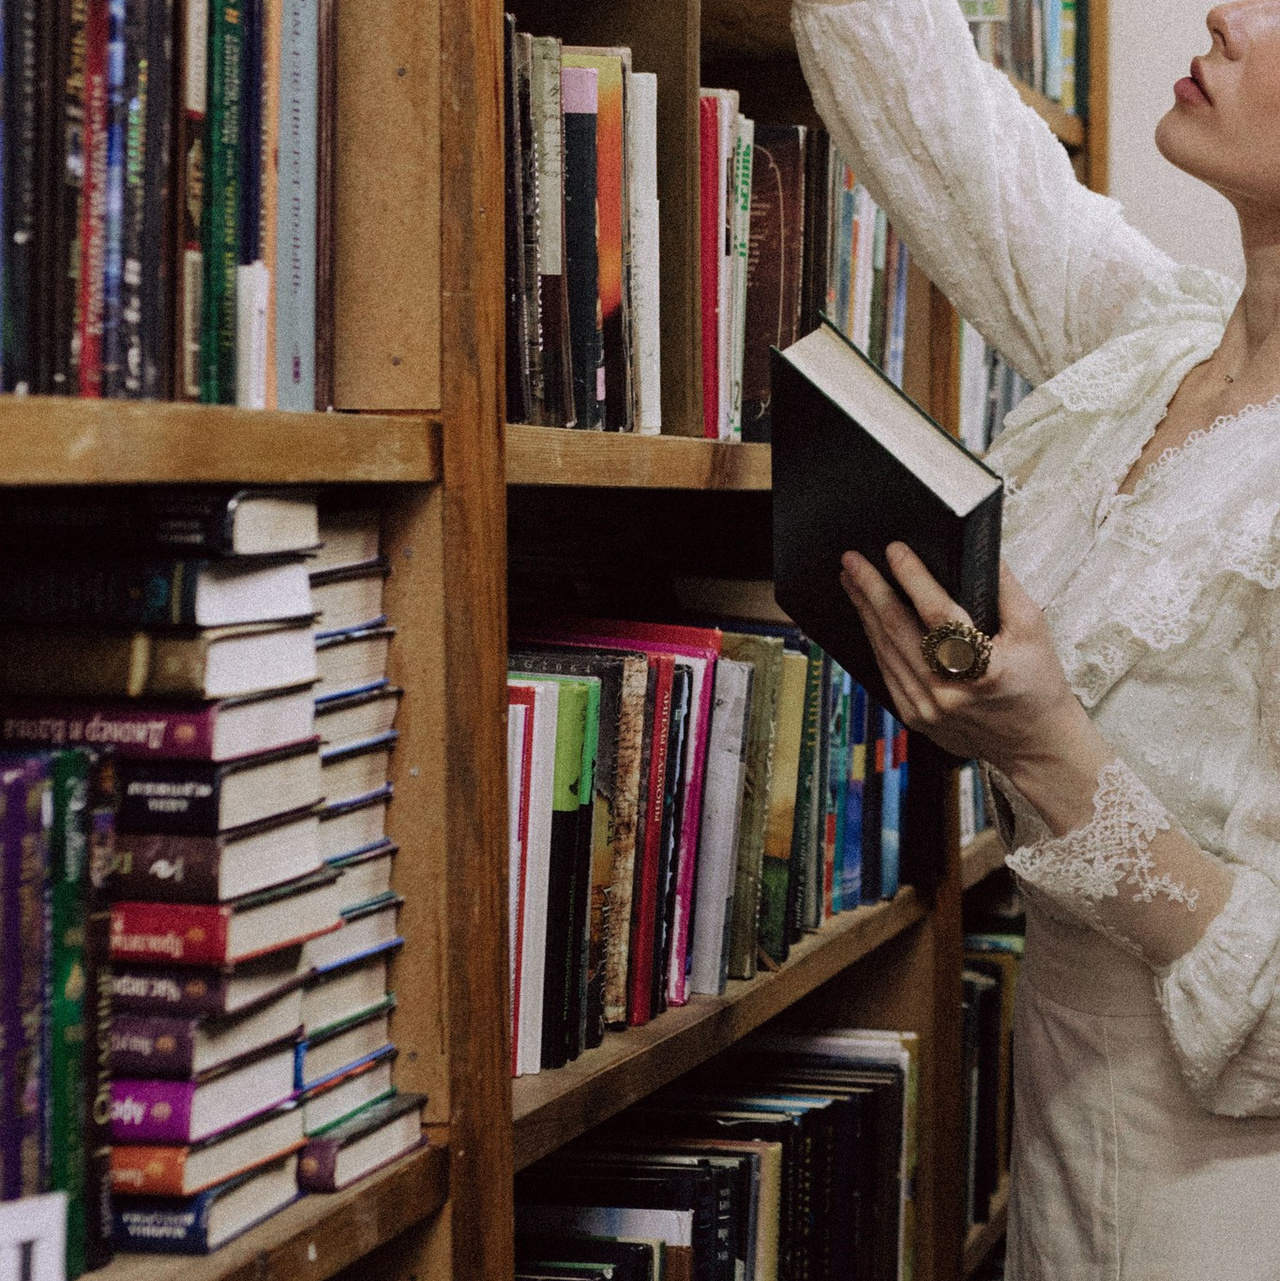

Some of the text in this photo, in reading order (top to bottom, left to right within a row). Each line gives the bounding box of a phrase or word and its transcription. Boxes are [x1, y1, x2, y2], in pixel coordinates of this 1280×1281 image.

[82, 714, 167, 751] Джокер
[657, 689, 671, 746] АНГЕЛЫ
[653, 758, 668, 823] ДЕМОНЫ
